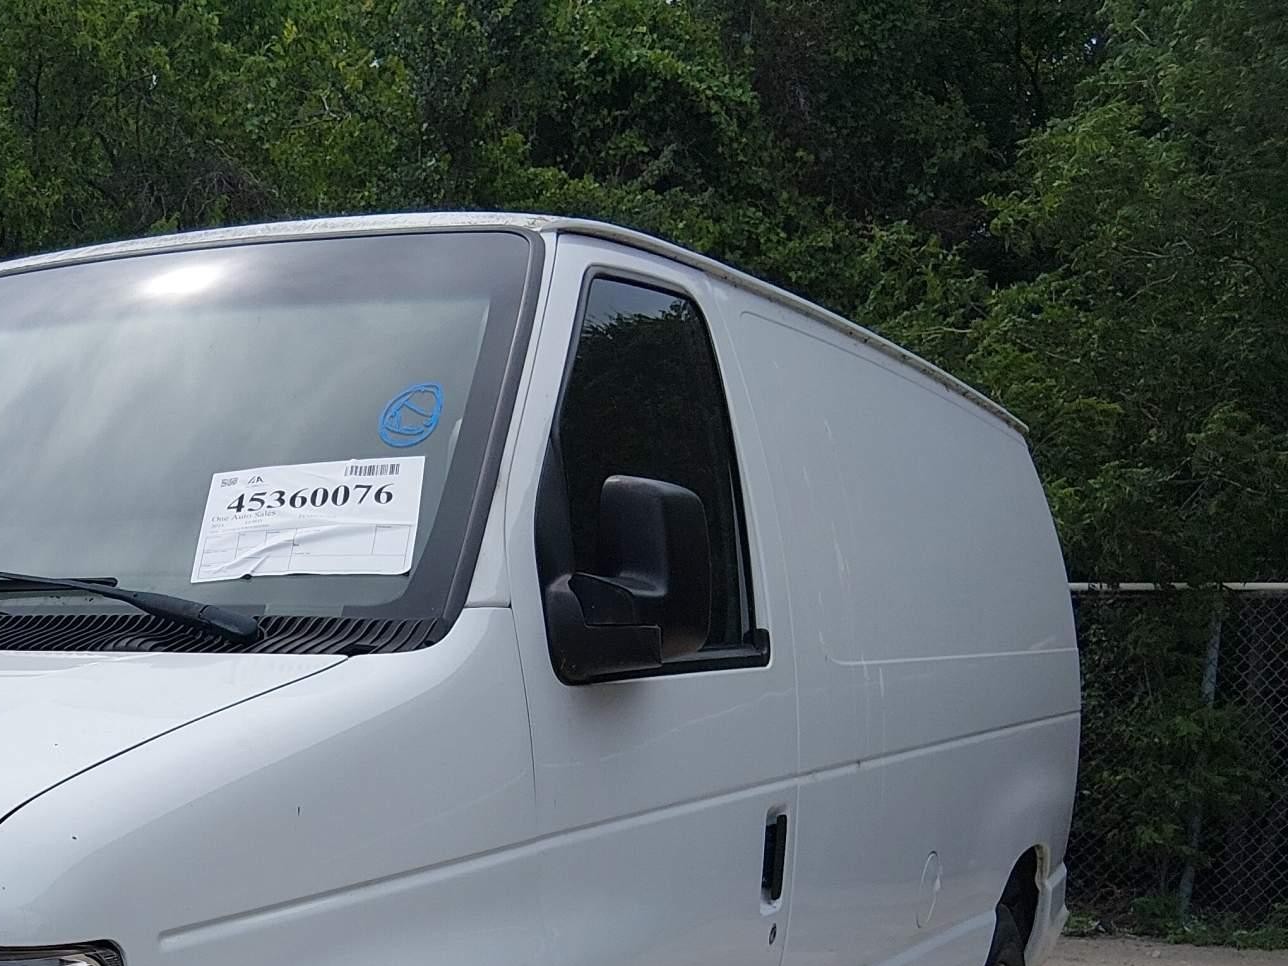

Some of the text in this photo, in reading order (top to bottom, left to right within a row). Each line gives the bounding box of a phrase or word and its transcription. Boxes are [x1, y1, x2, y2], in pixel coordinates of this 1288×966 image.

[226, 483, 395, 513] 45360076
[231, 512, 252, 521] Auto
[254, 510, 277, 519] Sales
